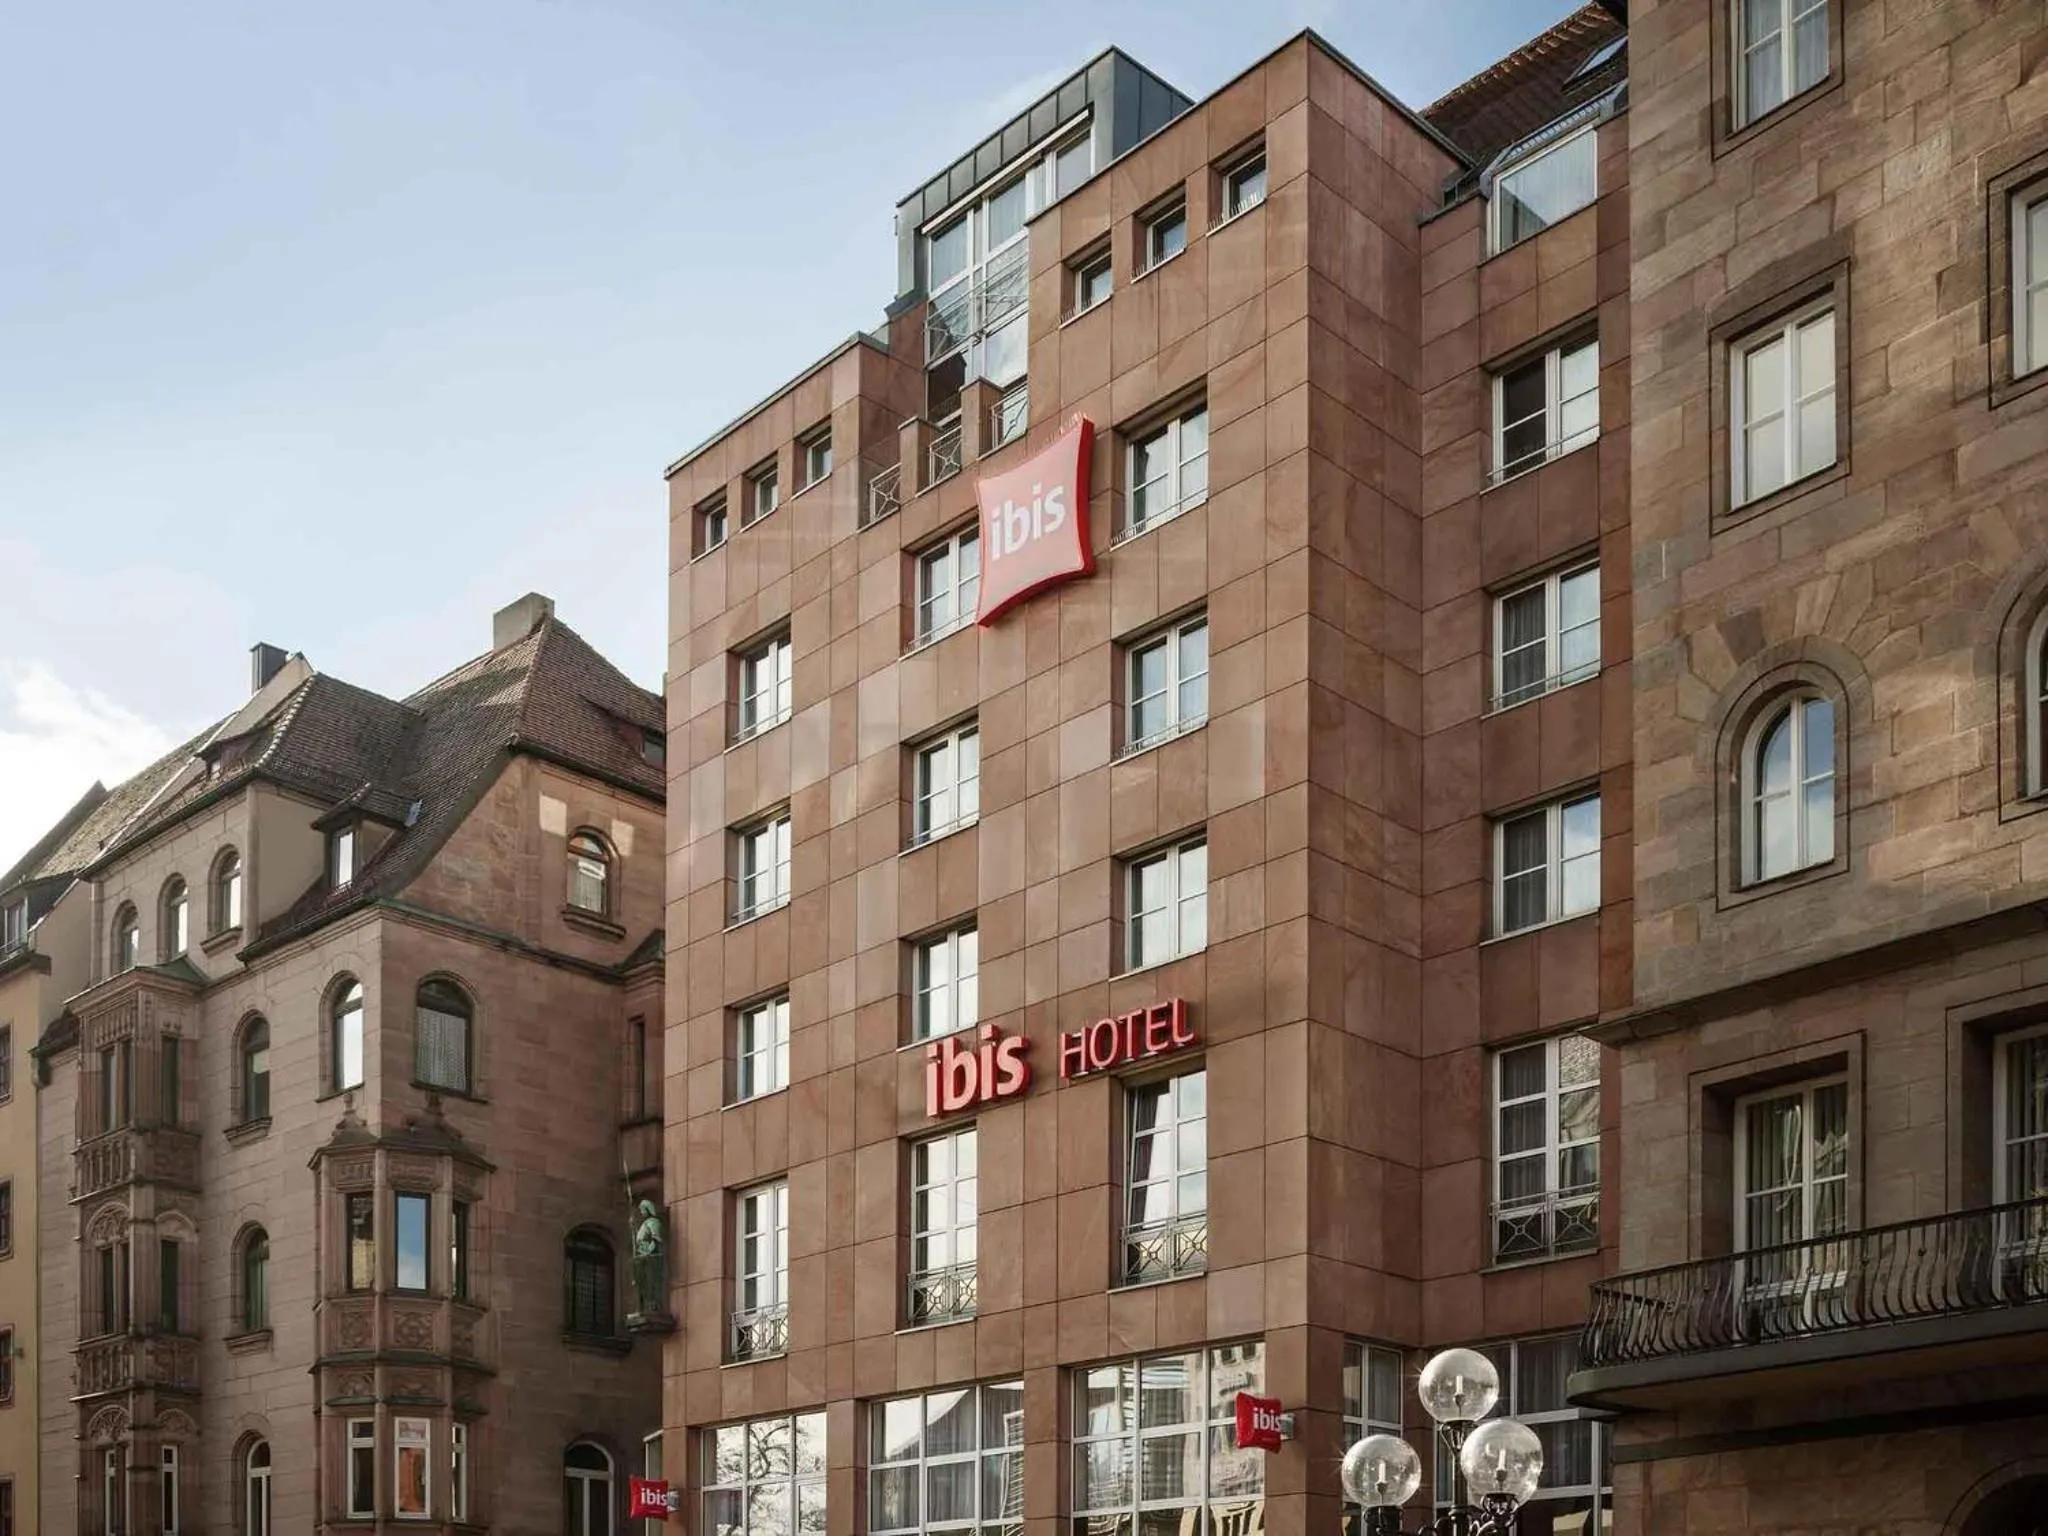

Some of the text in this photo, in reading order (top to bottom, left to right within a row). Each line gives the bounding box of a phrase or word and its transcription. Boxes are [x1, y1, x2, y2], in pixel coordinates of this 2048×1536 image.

[990, 482, 1066, 561] ibis
[926, 998, 1196, 1118] ibis HOTEL
[1253, 1407, 1281, 1431] ibis
[641, 1487, 667, 1506] ibis
